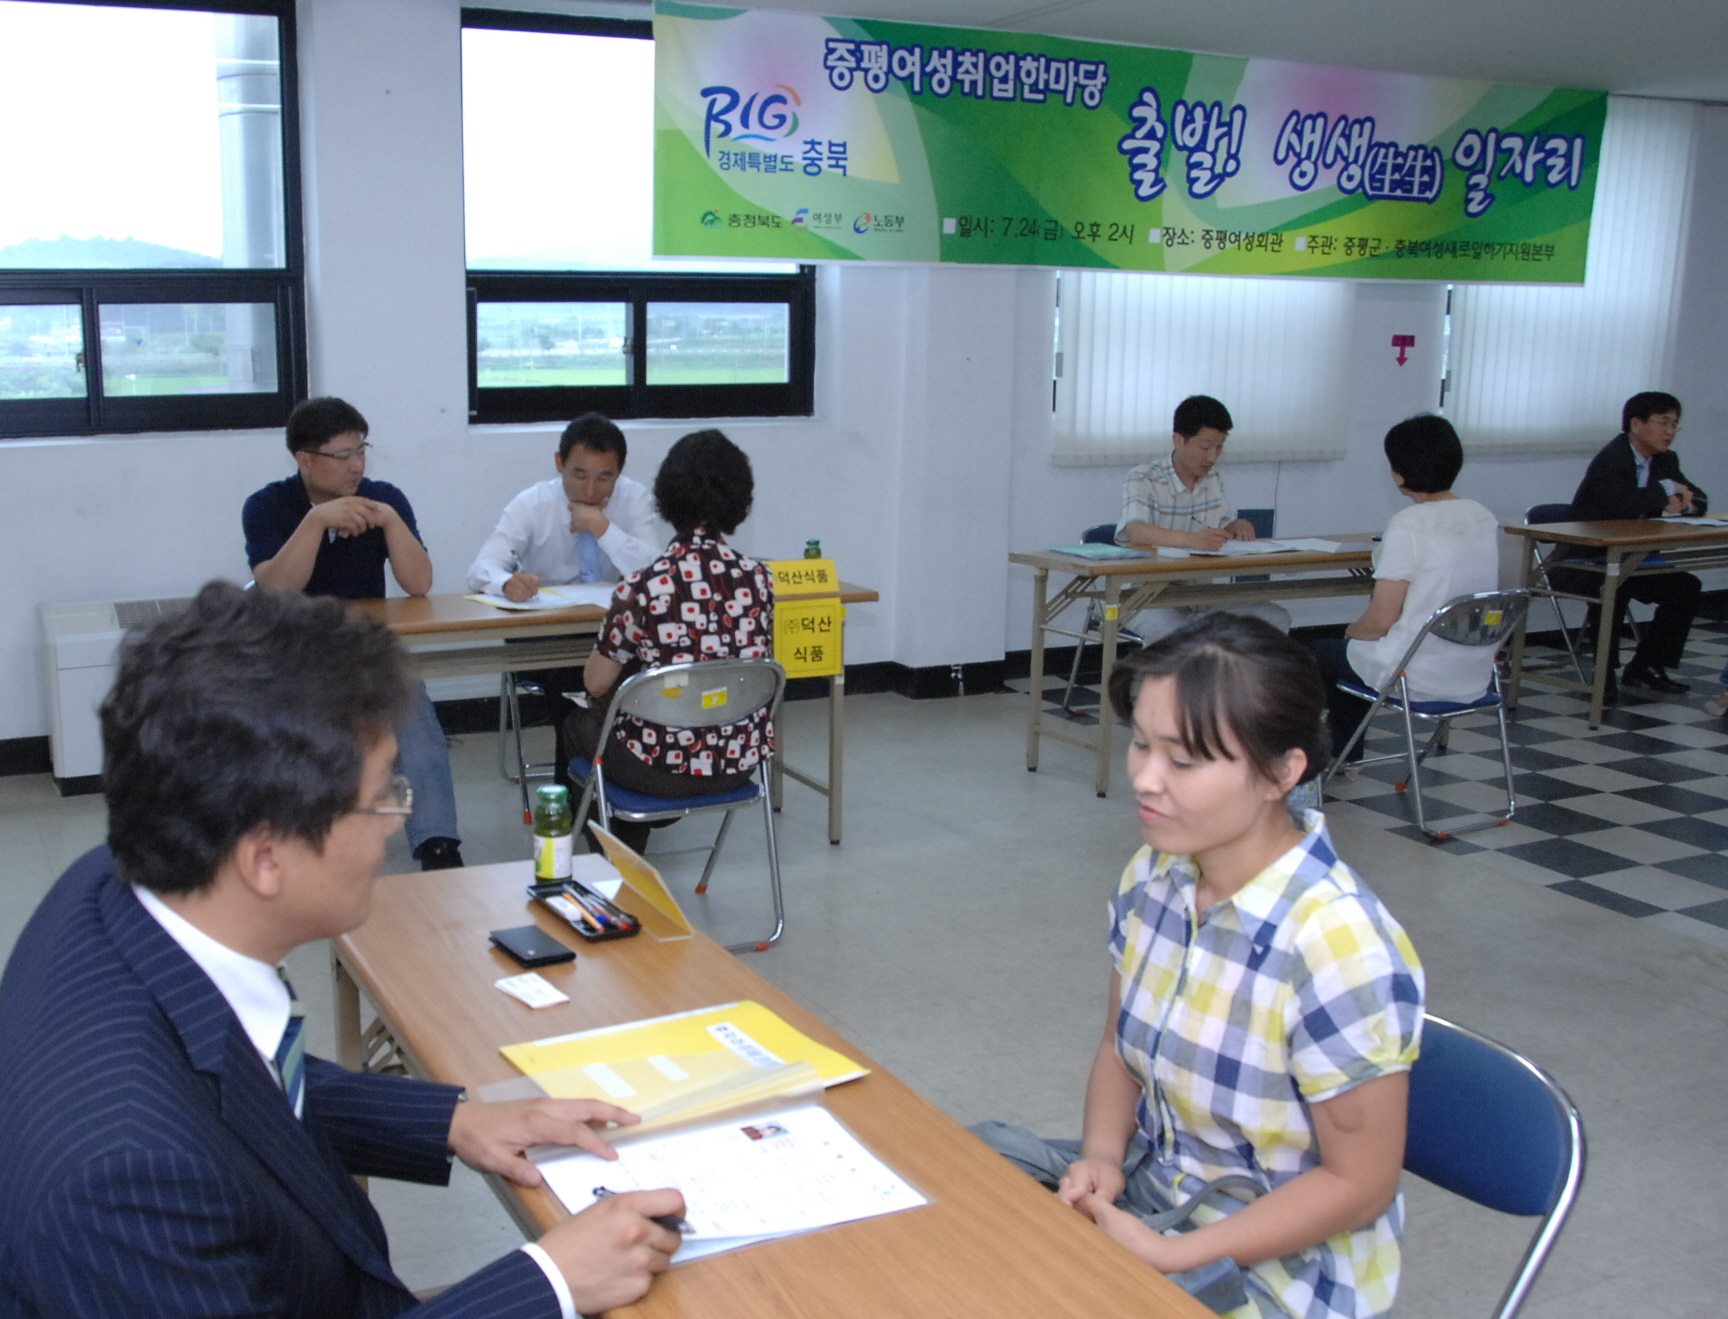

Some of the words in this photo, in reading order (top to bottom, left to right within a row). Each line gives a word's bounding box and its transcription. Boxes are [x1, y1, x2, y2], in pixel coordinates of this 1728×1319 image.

[823, 38, 1108, 109] 증평여성취업한마당
[700, 85, 790, 158] BIG
[718, 150, 795, 173] 경제특별도
[802, 139, 848, 177] 충북
[1117, 86, 1247, 202] 출발!
[1452, 127, 1586, 218] 일자리
[728, 213, 783, 228] 충청북도
[813, 212, 843, 225] 여성부
[873, 214, 905, 228] 노동부
[958, 216, 995, 238] 일시:
[1072, 221, 1102, 242] 오후
[1108, 222, 1135, 245] 2시
[1162, 226, 1195, 248] 장소:
[1201, 229, 1284, 253] 증평여성회관
[1307, 235, 1337, 255] 주관:
[1344, 236, 1382, 257] 증평군
[794, 645, 825, 662] 식품
